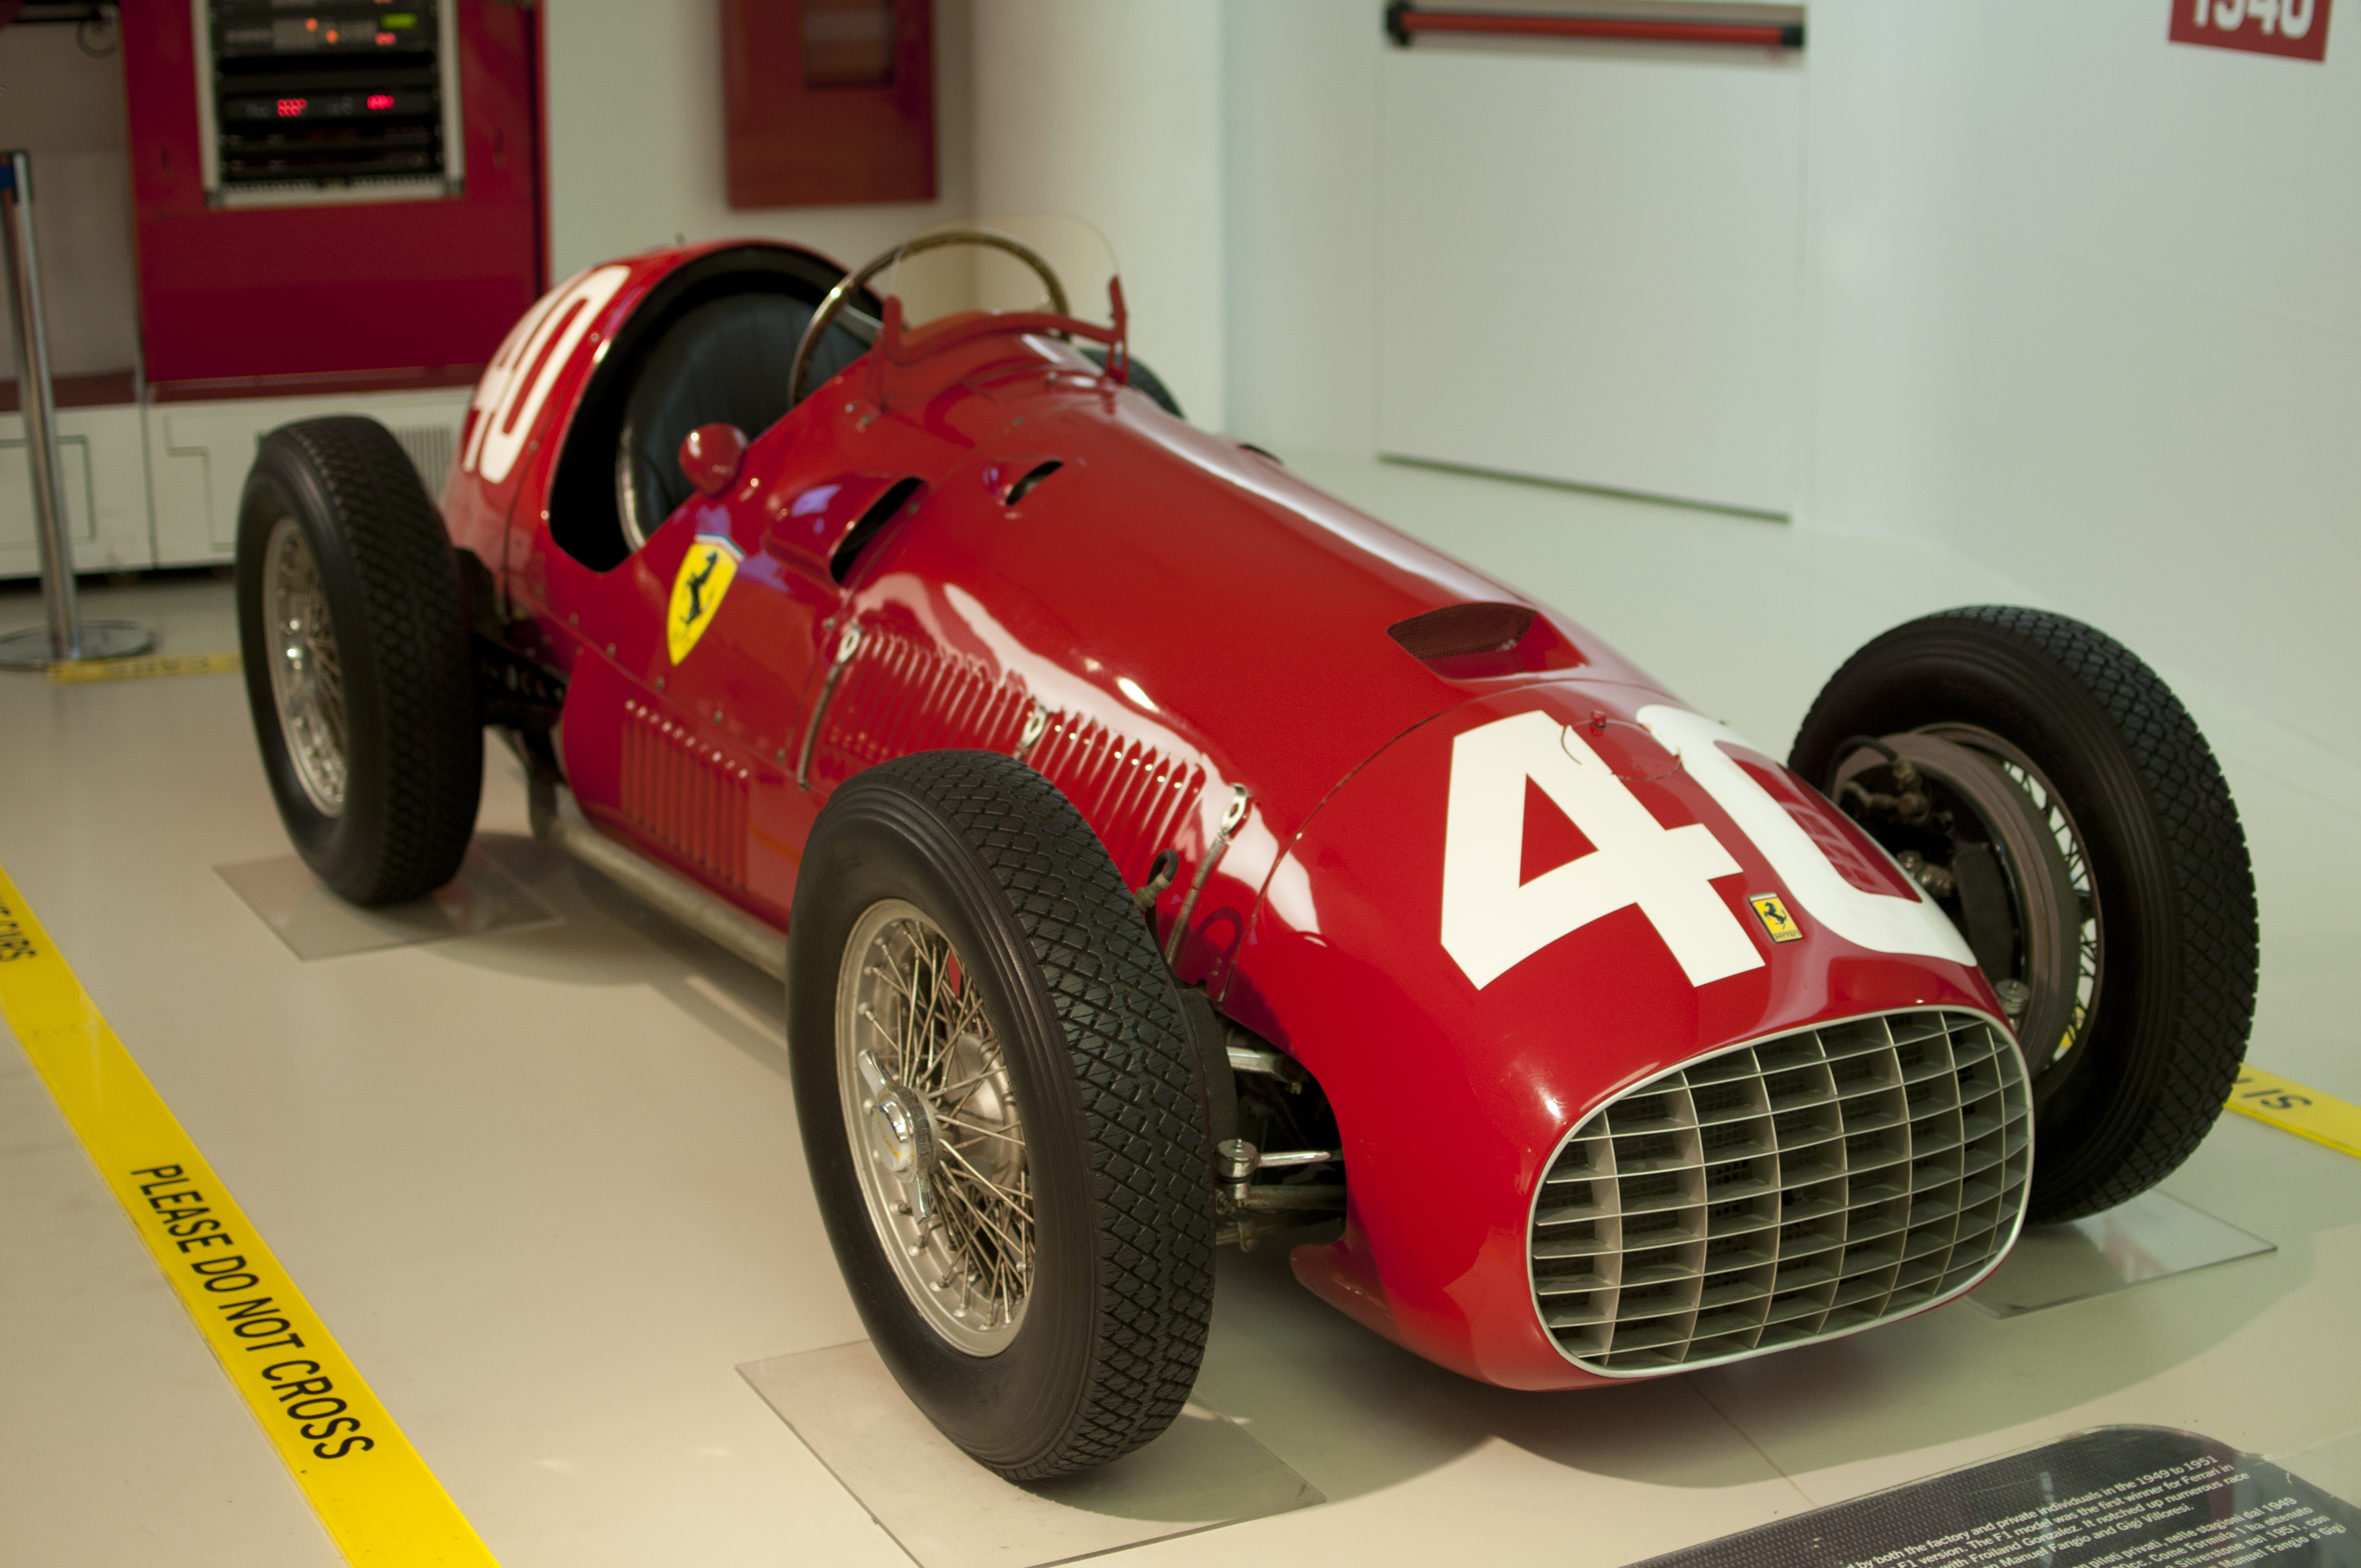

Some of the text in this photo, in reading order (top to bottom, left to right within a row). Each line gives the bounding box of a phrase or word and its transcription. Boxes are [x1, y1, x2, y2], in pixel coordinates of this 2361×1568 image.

[130, 1164, 375, 1460] PLEASE DO NOT CROSS
[1873, 1550, 1905, 1564] both
[1904, 1544, 1927, 1555] the
[1927, 1531, 1970, 1548] factory
[1971, 1522, 1996, 1536] and
[1996, 1511, 2038, 1529] private
[2037, 1492, 2103, 1515] individuals
[2115, 1480, 2137, 1491] the
[2136, 1469, 2170, 1485] 1949
[2184, 1455, 2218, 1471] 1951
[1918, 1547, 1968, 1564] version.
[1966, 1538, 1994, 1549] The
[1992, 1531, 2013, 1542] F1
[2014, 1518, 2053, 1536] model
[2053, 1512, 2079, 1523] was
[2077, 1506, 2100, 1516] the
[2098, 1497, 2125, 1510] first
[2124, 1486, 2164, 1502] winner
[2163, 1481, 2182, 1490] for
[2180, 1467, 2221, 1484] Ferrari
[2218, 1464, 2234, 1473] in
[1968, 1541, 2022, 1563] Froiland
[2022, 1526, 2083, 1546] Gonzalez.
[2082, 1519, 2096, 1528] It
[2096, 1503, 2146, 1524] notched
[2146, 1499, 2164, 1509] up
[2164, 1481, 2223, 1503] numerous
[2223, 1472, 2250, 1485] race
[1999, 1503, 2195, 1567] Manuel Fangio and Gigi Villoresi.
[2088, 1552, 2124, 1568] piloti
[2164, 1530, 2198, 1544] nelle
[2196, 1515, 2246, 1533] stagioni
[2243, 1507, 2266, 1519] dal
[2262, 1497, 2298, 1512] 1949
[2148, 1547, 2188, 1562] Come
[2184, 1531, 2238, 1551] Formula
[2244, 1522, 2266, 1532] ha
[2264, 1506, 2314, 1526] ottenuto
[2174, 1543, 2246, 1568] Silverstone
[2245, 1534, 2268, 1546] nel
[2305, 1515, 2331, 1526] con
[2217, 1549, 2268, 1568] Manuel
[2265, 1536, 2310, 1553] Fangio
[2318, 1522, 2347, 1536] Gigi
